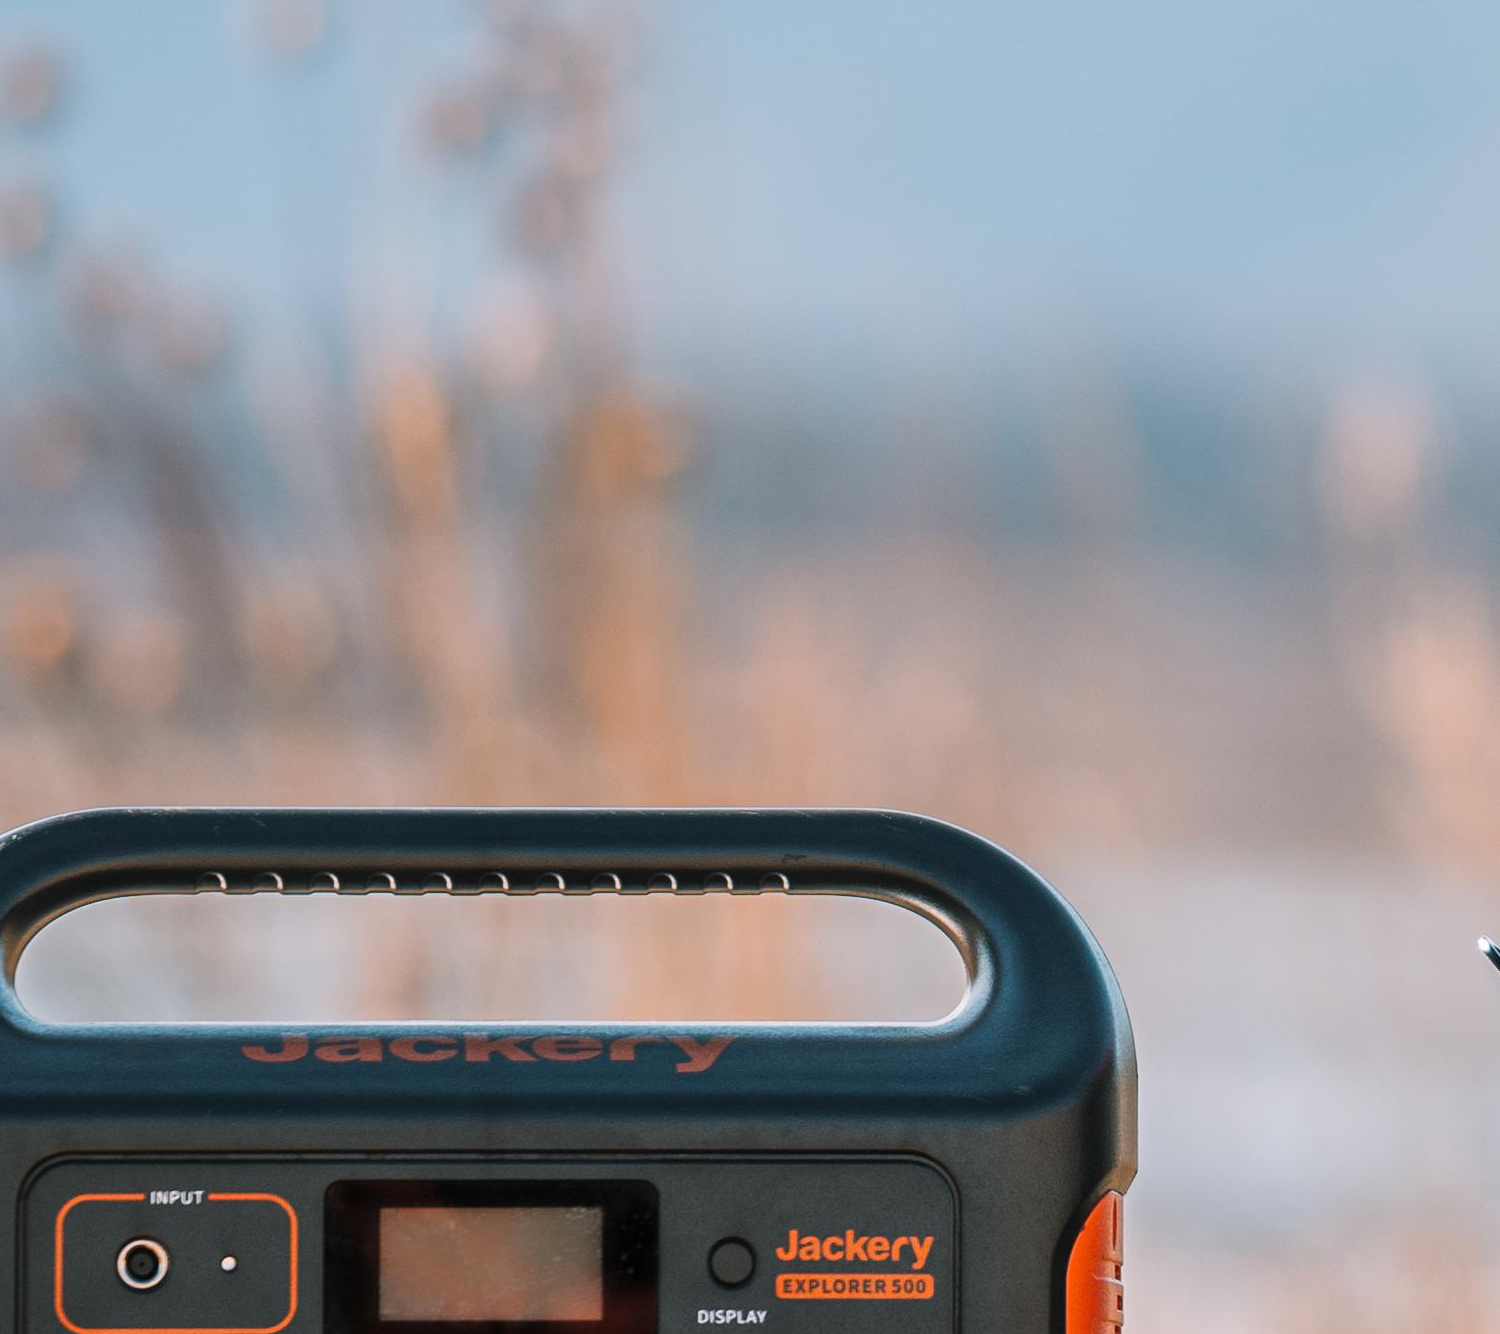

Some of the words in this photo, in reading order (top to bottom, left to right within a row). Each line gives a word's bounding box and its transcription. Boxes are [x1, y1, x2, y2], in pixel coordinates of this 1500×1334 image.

[240, 1032, 740, 1072] Jackery
[150, 1190, 204, 1205] INPUT
[775, 1228, 934, 1270] Jackery
[783, 1279, 886, 1294] EXPLORER
[892, 1279, 927, 1294] 500
[697, 1310, 767, 1324] DISPLAY
